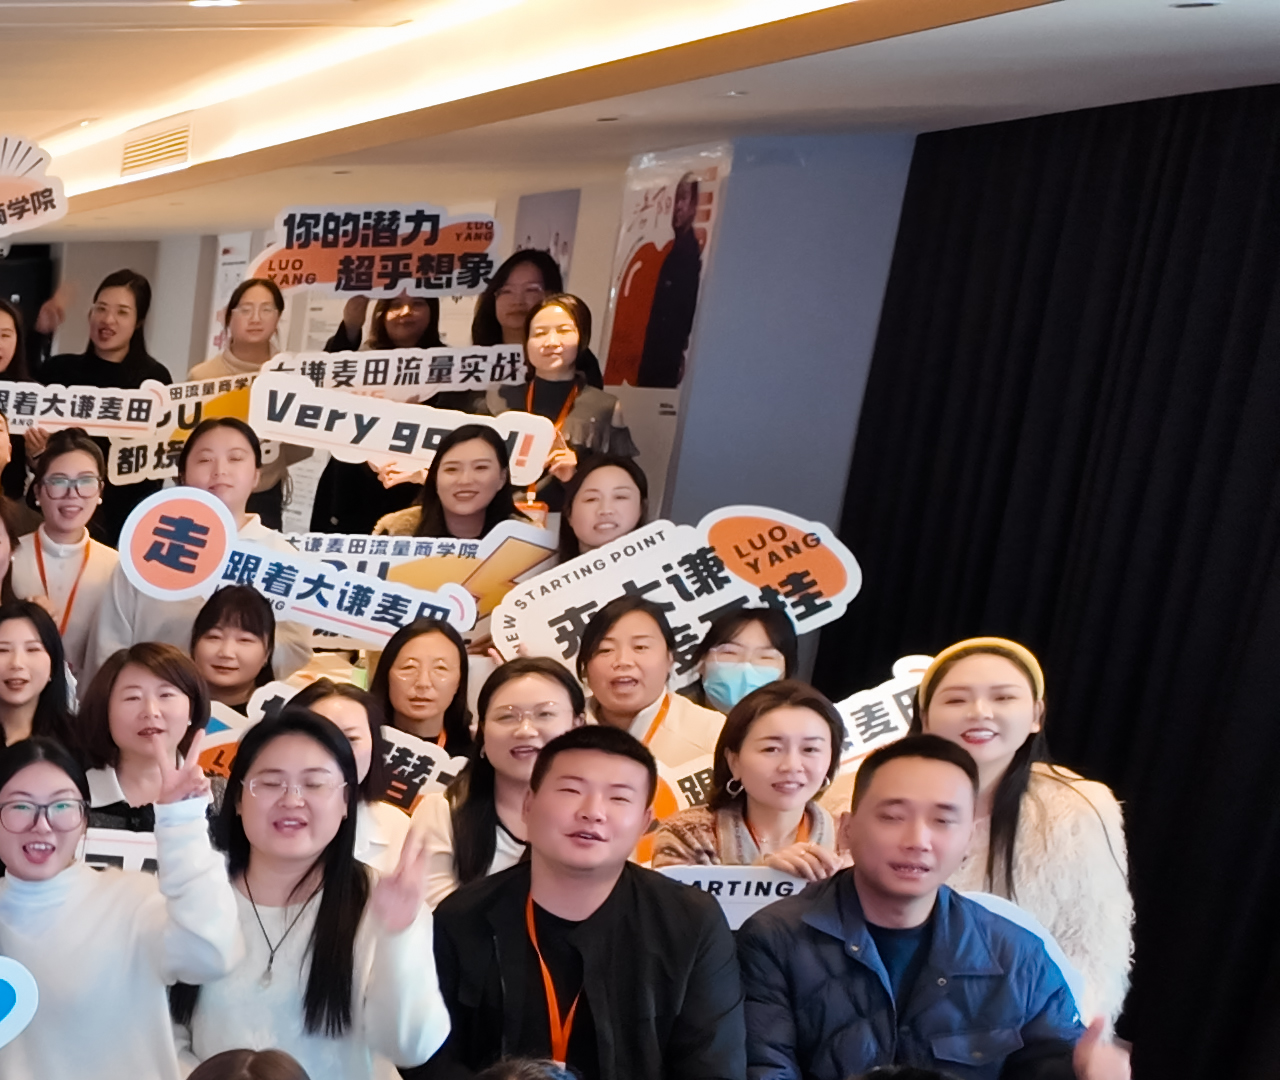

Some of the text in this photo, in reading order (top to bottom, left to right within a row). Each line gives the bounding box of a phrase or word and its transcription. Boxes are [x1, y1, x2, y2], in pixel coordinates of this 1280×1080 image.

[283, 209, 441, 250] 你的潜力
[267, 259, 304, 272] LUO
[335, 253, 494, 292] 超乎想象
[267, 389, 535, 468] Very go!
[143, 514, 211, 574] 走
[733, 525, 788, 559] LUO
[743, 532, 822, 576] YANG
[220, 550, 452, 628] 跟着大谦麦田
[514, 558, 606, 611] STARTING
[610, 529, 667, 564] POINT
[689, 880, 795, 897] ARTING
